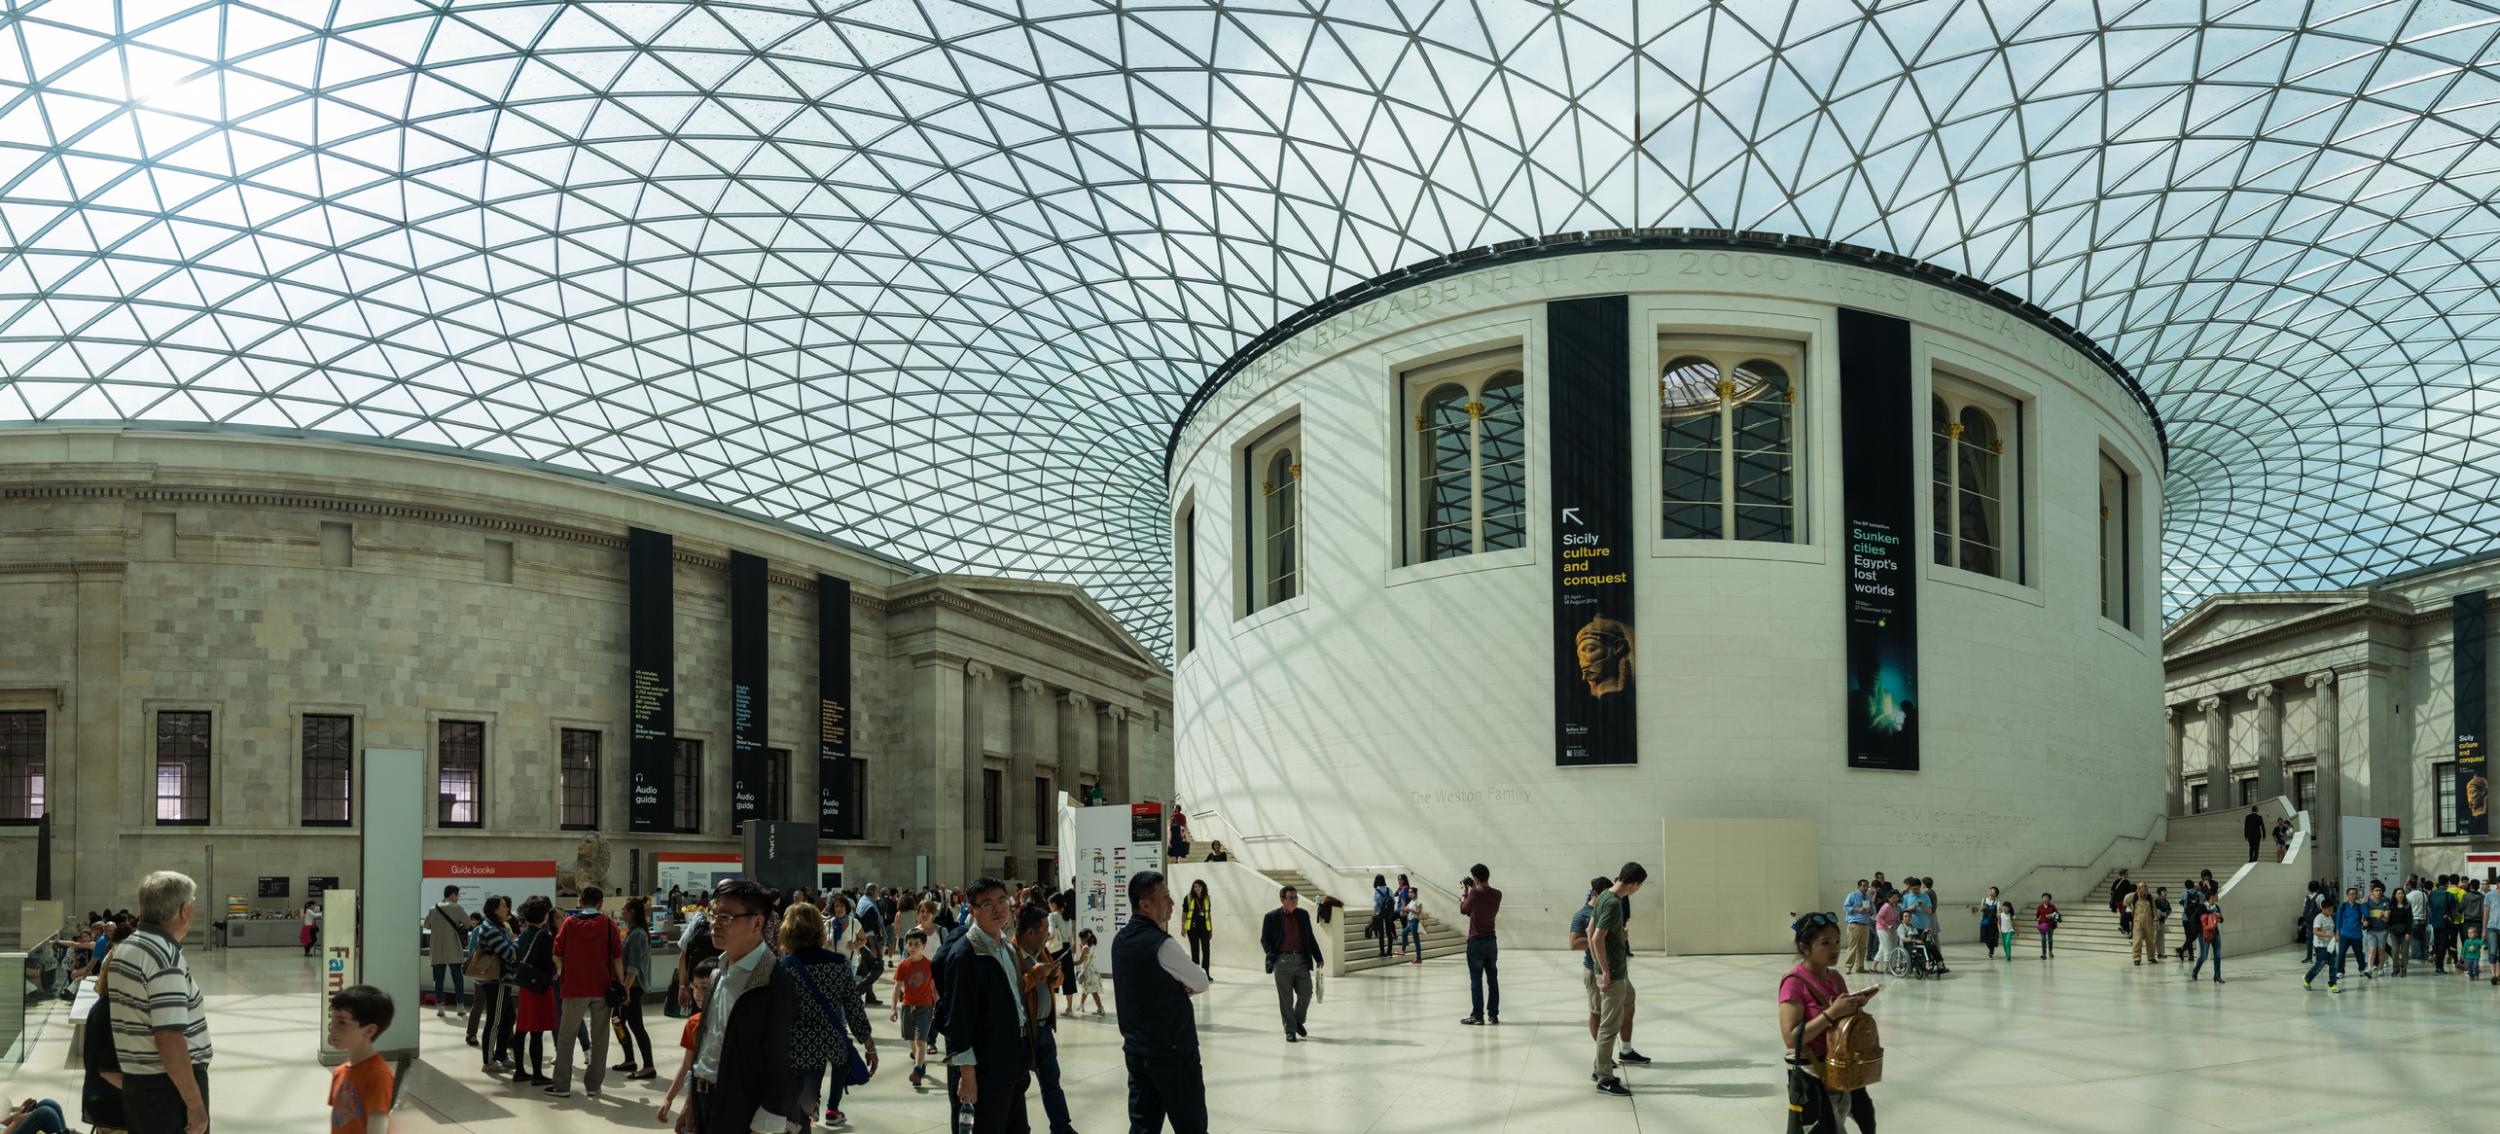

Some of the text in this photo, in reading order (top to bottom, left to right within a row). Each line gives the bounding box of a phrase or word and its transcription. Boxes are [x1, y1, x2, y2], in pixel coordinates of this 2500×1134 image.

[1313, 264, 1519, 351] ELIZABETH
[1536, 258, 1569, 285] II
[1585, 252, 1655, 279] AD
[1677, 252, 1795, 281] 2000
[1812, 262, 1910, 302] THIS
[1928, 288, 2036, 349] GREAT
[2046, 337, 2114, 398] COURT
[1563, 533, 1599, 545] Sicily
[1853, 528, 1900, 544] Sunken
[1563, 547, 1610, 558] culture
[1853, 543, 1886, 555] cities
[1563, 560, 1589, 572] and
[1854, 554, 1898, 570] Egypt's
[1563, 572, 1628, 586] conquest
[1854, 567, 1877, 580] lost
[1854, 583, 1895, 596] worlds
[2459, 734, 2474, 742] Sicily
[2459, 755, 2485, 763] conquest
[635, 785, 658, 794] Audio
[635, 795, 657, 805] guide
[736, 792, 754, 801] Audio
[1434, 789, 1482, 804] Weston
[1487, 787, 1531, 803] Family
[736, 801, 754, 810] guide
[823, 798, 839, 807] Audio
[823, 807, 839, 815] guide
[451, 865, 495, 874] Guide books
